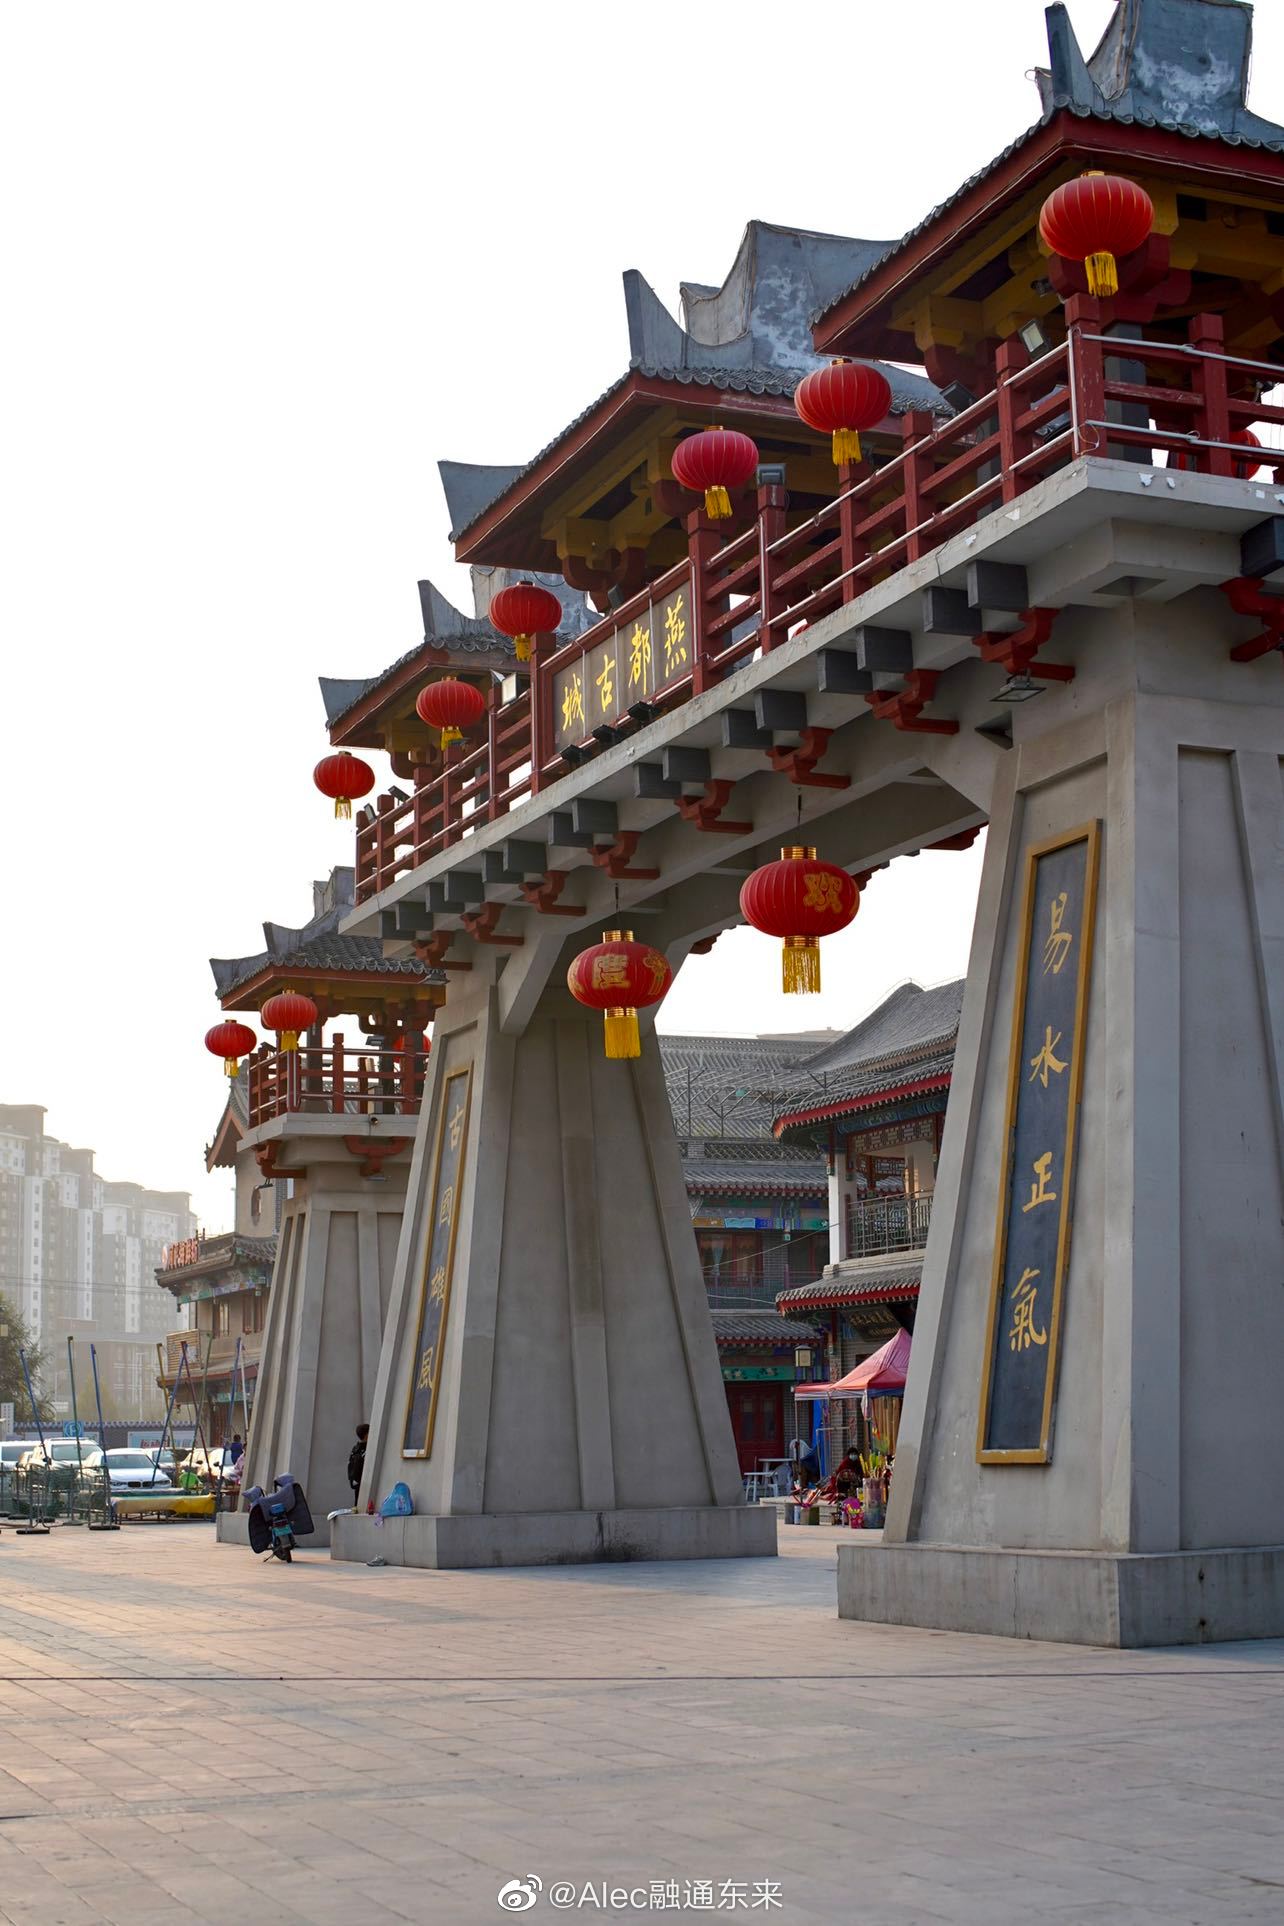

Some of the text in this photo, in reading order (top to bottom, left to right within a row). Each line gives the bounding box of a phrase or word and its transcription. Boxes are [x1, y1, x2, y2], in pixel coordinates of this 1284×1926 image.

[561, 594, 687, 731] 燕都古城
[1009, 892, 1072, 1352] 易水正氣
